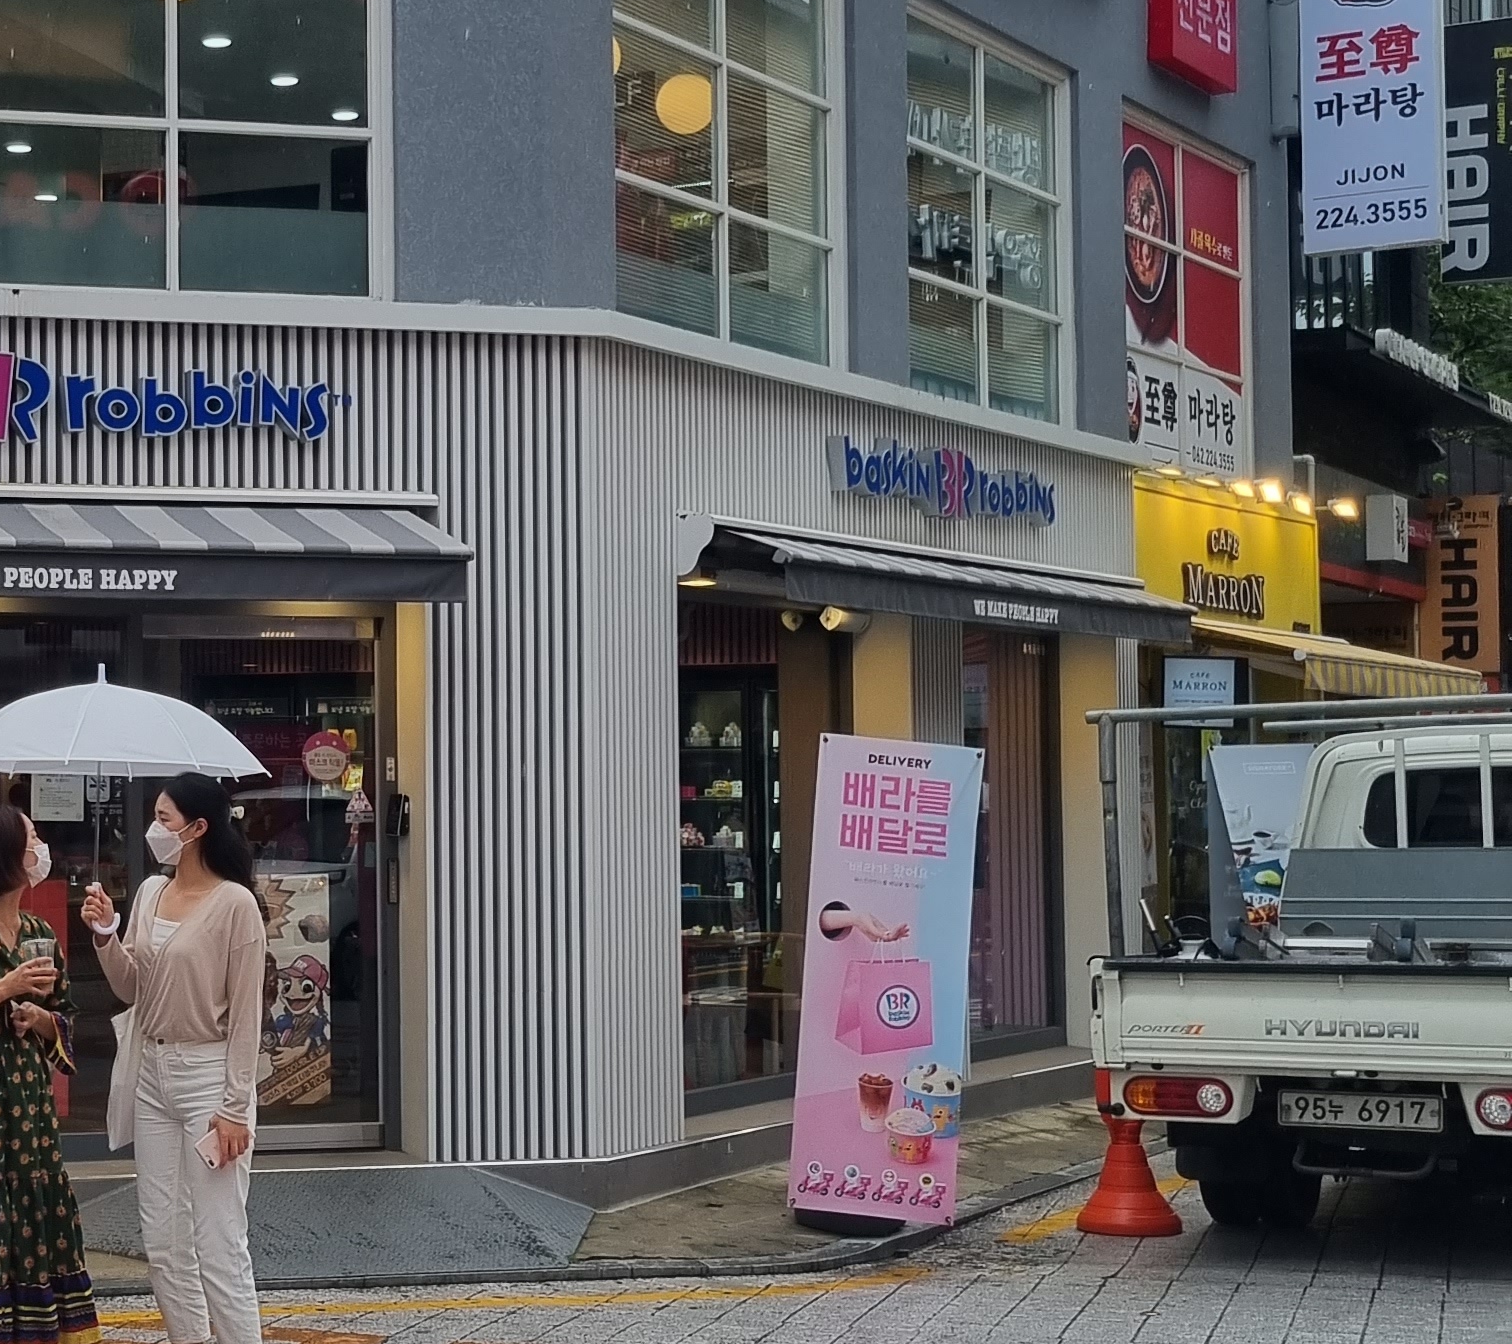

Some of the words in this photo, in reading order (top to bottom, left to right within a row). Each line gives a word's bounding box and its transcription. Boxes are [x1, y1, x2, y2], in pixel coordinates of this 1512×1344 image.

[1315, 23, 1421, 83] 至尊
[1314, 83, 1425, 127] 마라탕
[1336, 162, 1406, 186] JIJON
[1315, 197, 1428, 230] 224.3555
[60, 368, 330, 443] robbins
[1144, 374, 1178, 433] 至尊
[1187, 388, 1237, 447] 마라탕
[843, 434, 931, 500] baskin
[978, 470, 1057, 527] robbins
[3, 567, 93, 590] PEOPLE
[99, 569, 178, 591] HAPPY
[1186, 563, 1264, 616] MARRON
[1440, 539, 1480, 661] HAIR
[974, 599, 986, 617] WE
[987, 600, 1008, 619] MAKE
[1009, 602, 1035, 622] PEOPLE
[1036, 605, 1059, 625] HAPPY
[1172, 679, 1228, 692] MARRON
[868, 753, 932, 769] DELIVERY
[842, 771, 952, 817] 배라를
[839, 813, 948, 858] 배달로
[1264, 1018, 1420, 1040] HYUNDAI
[1294, 1096, 1345, 1121] 95누
[1357, 1099, 1427, 1125] 6917
